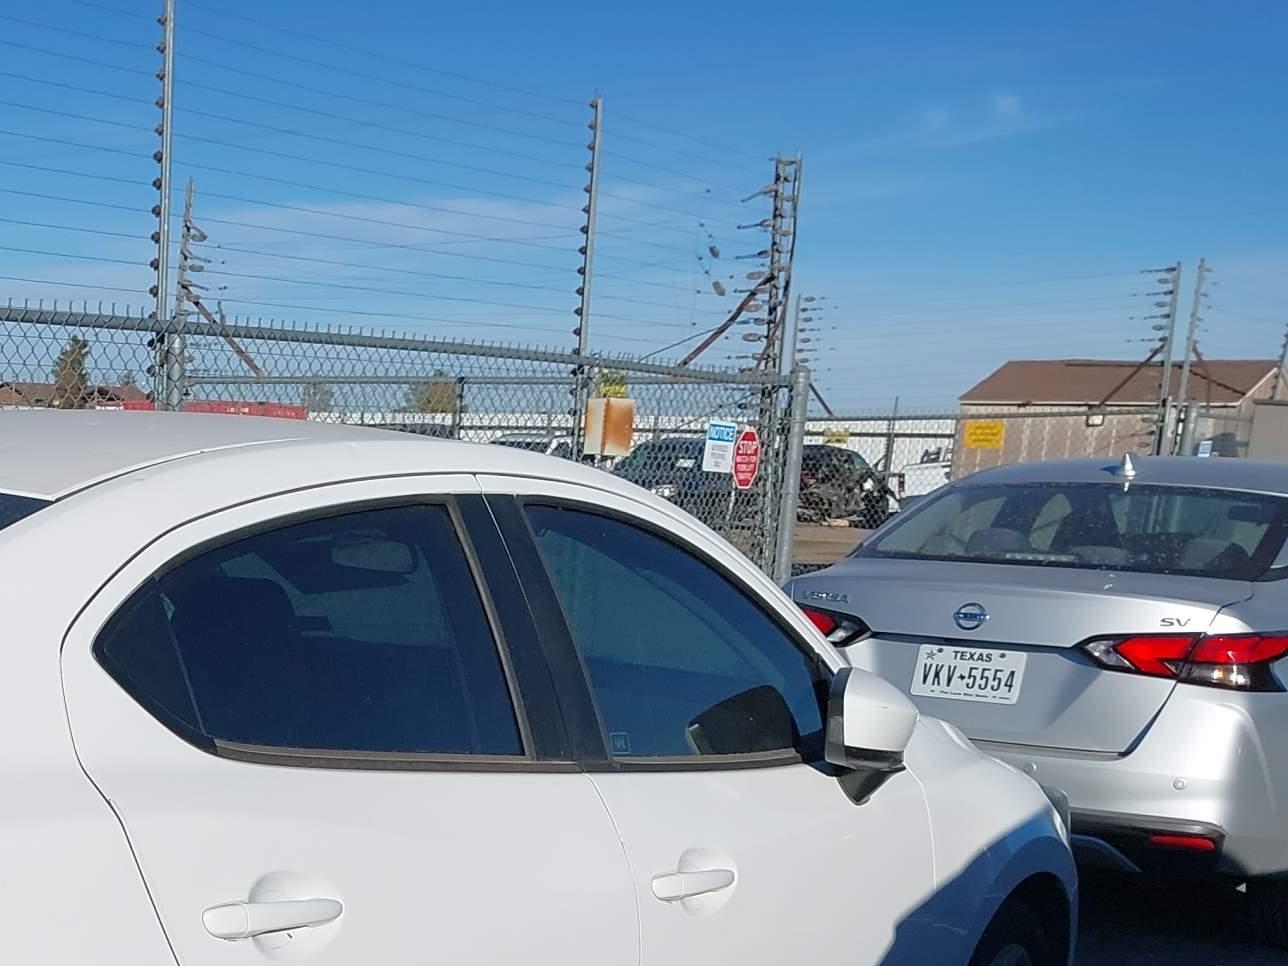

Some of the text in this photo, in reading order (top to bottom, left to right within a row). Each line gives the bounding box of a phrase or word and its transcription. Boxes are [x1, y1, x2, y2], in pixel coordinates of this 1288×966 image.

[709, 425, 735, 441] NOTICE
[738, 440, 758, 454] STOP
[1159, 617, 1191, 627] SV
[952, 650, 993, 663] TEXAS
